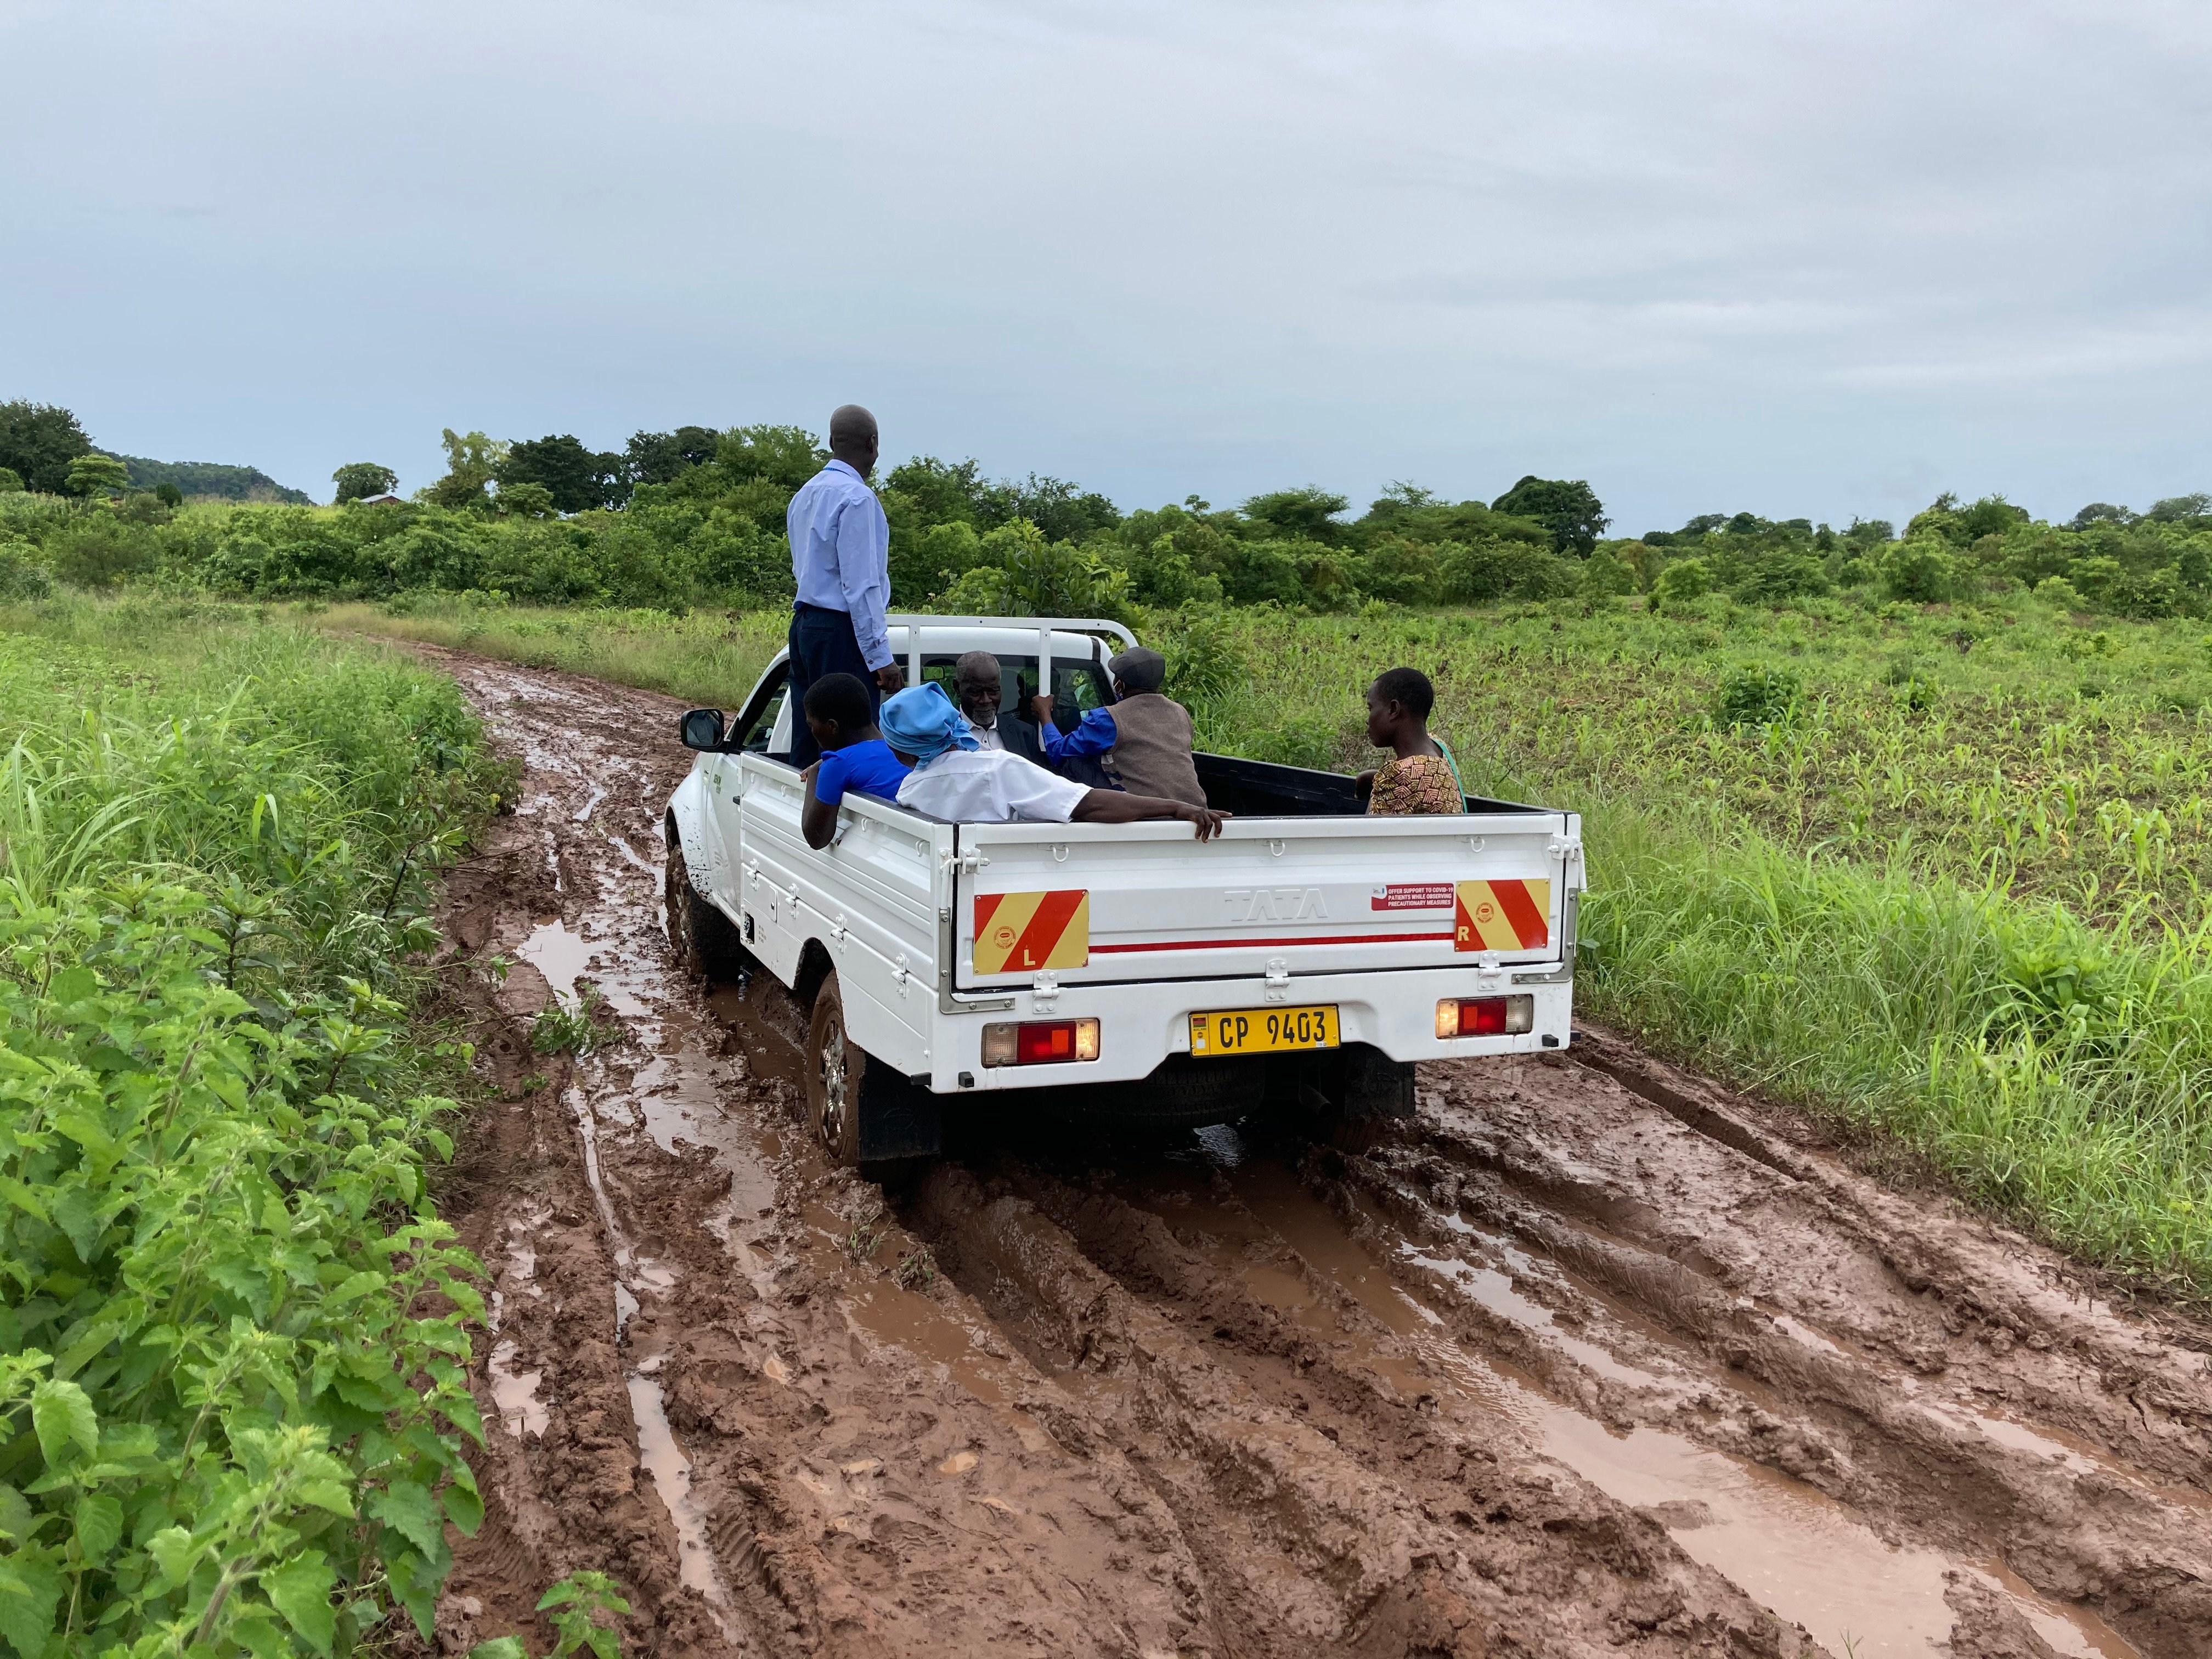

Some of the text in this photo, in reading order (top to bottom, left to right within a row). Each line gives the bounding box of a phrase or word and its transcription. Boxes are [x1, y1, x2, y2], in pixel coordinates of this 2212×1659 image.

[1224, 889, 1328, 922] TATA
[1458, 926, 1470, 941] R
[1024, 949, 1036, 966] L
[1220, 1012, 1325, 1048] CP 9403
